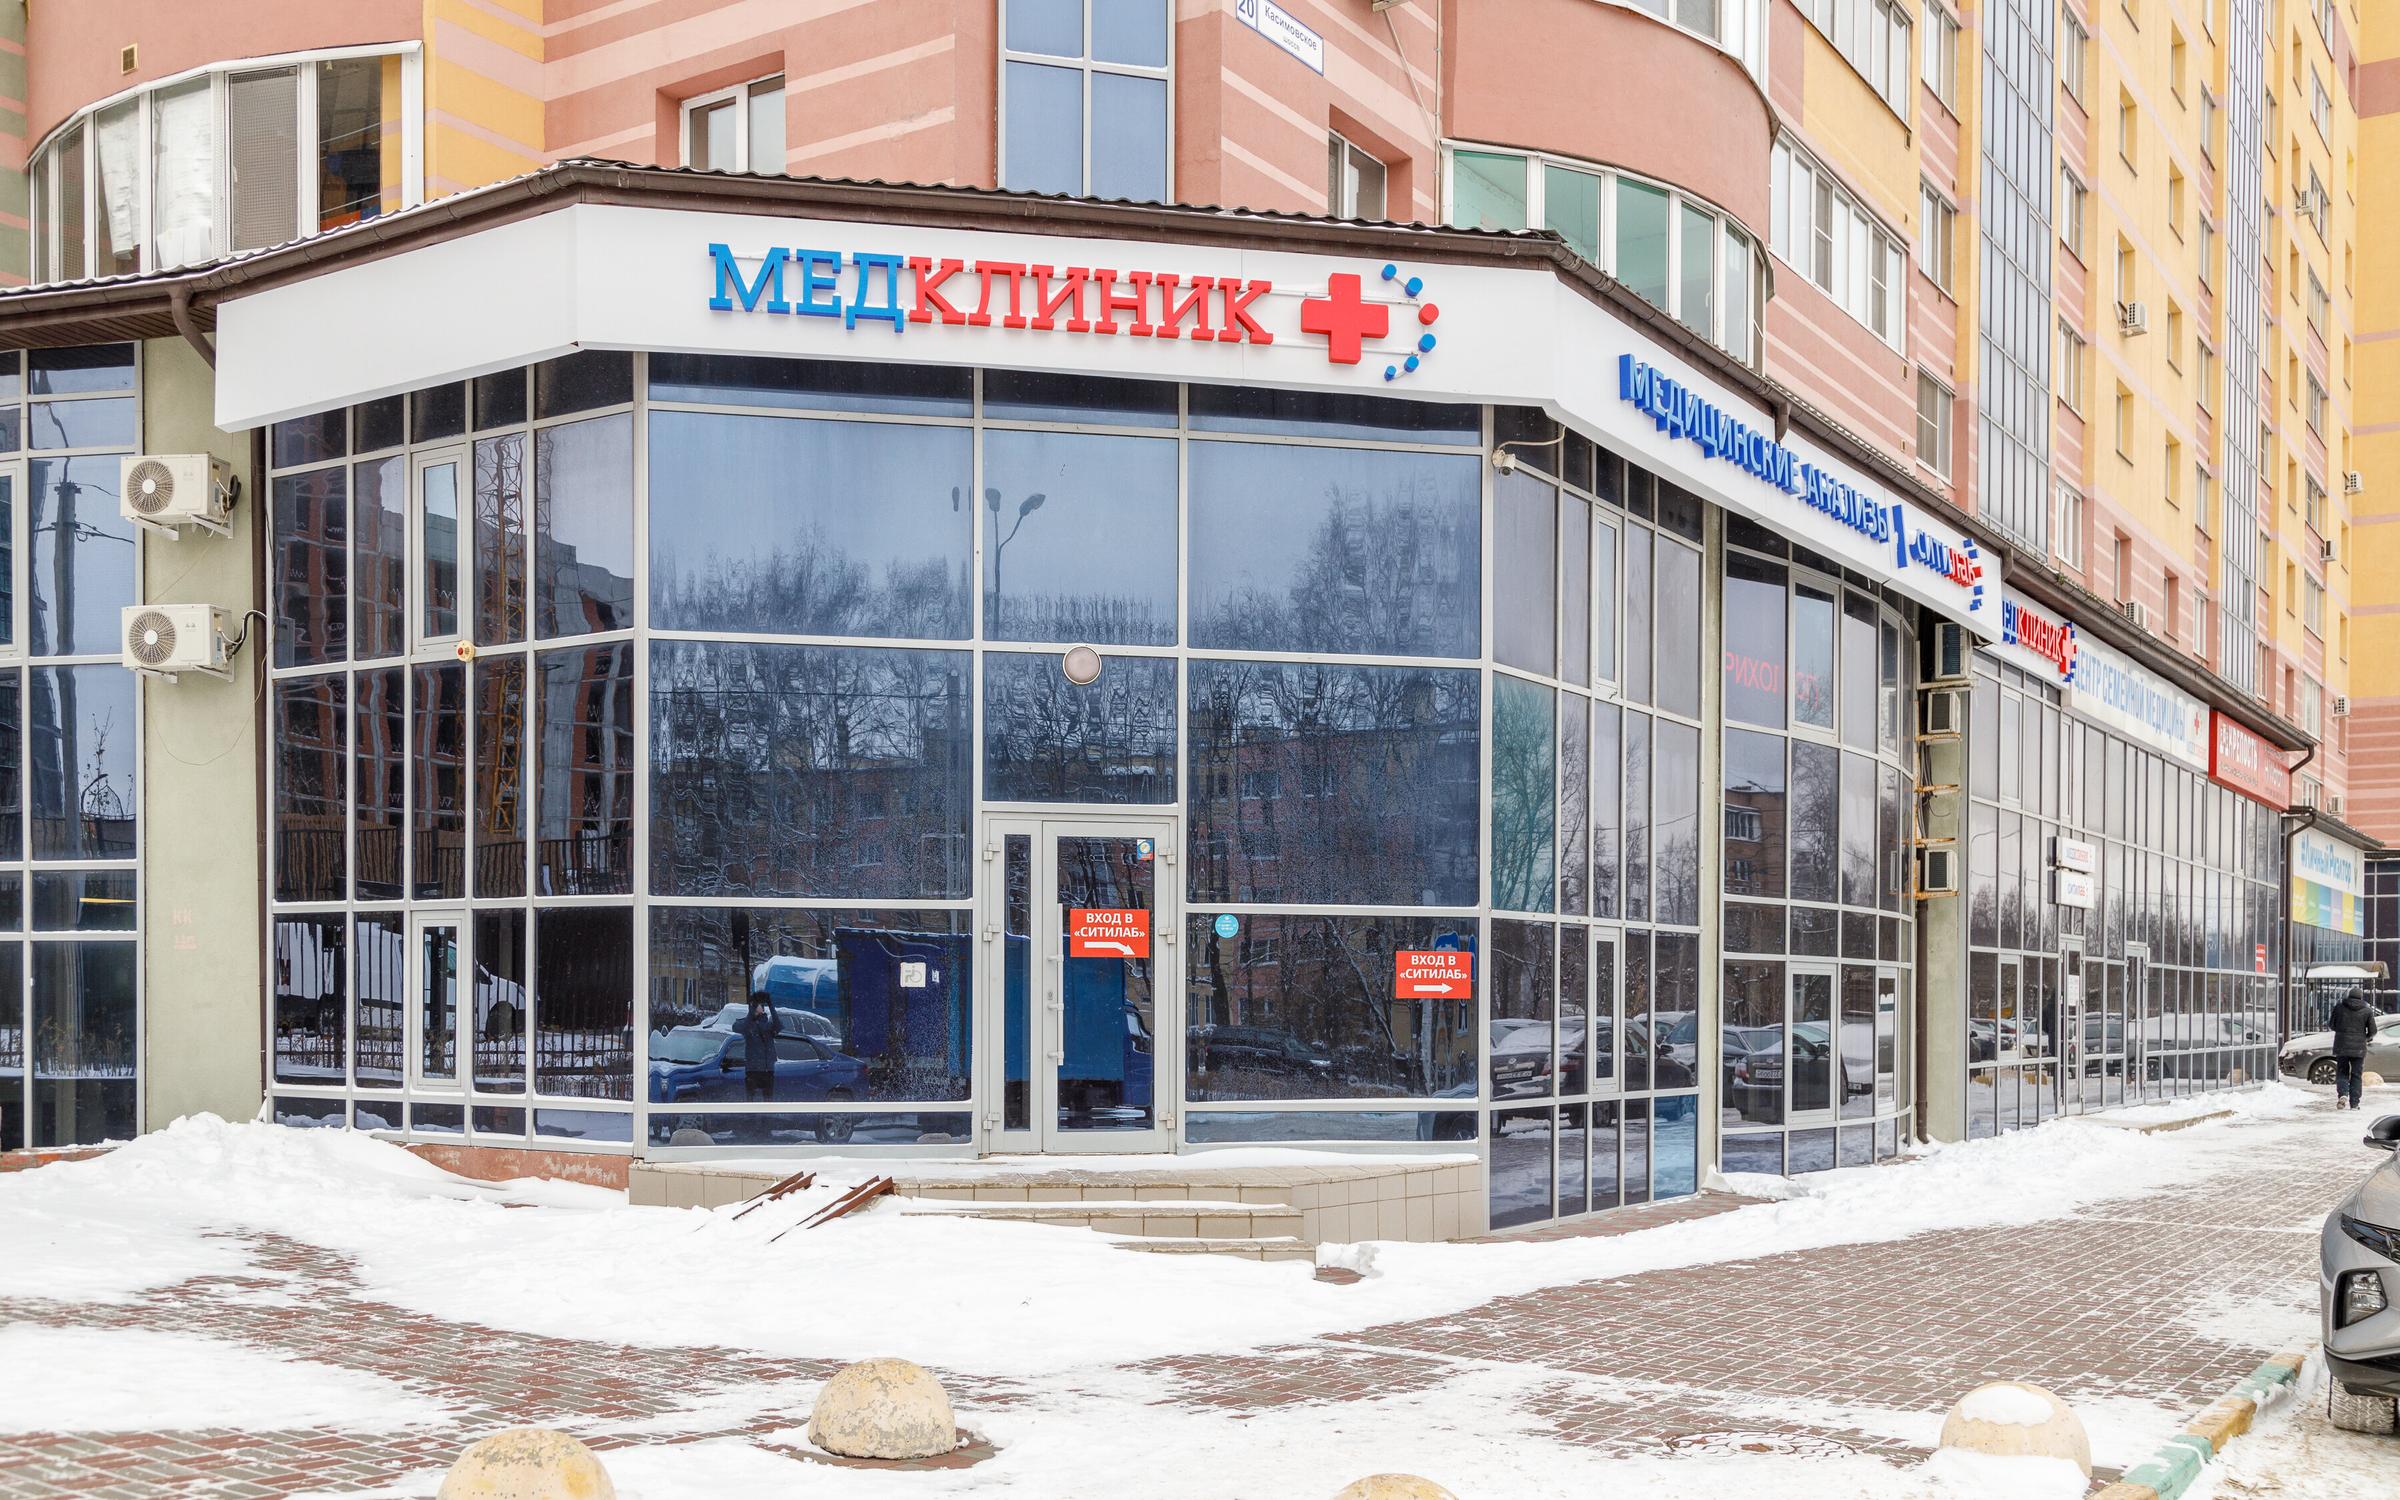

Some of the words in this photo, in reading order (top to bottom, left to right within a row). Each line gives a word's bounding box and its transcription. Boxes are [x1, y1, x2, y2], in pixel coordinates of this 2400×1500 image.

[1238, 0, 1254, 18] 20
[1265, 5, 1317, 51] Касимовское
[709, 243, 1273, 345] МЕДКЛИНИК
[1619, 354, 1800, 495] МЕДИЦИНСКИЕ
[1800, 463, 1890, 543] АНАЛИЗЫ
[2002, 599, 2064, 664] ЕДКЛИНИК
[1086, 913, 1121, 925] ВХОД
[1125, 913, 1133, 924] В
[1074, 926, 1145, 938] «СИТИЛАБ»
[1411, 955, 1445, 967] ВХОД
[1448, 955, 1456, 965] В
[1400, 968, 1467, 979] «СИТИЛАБ»
